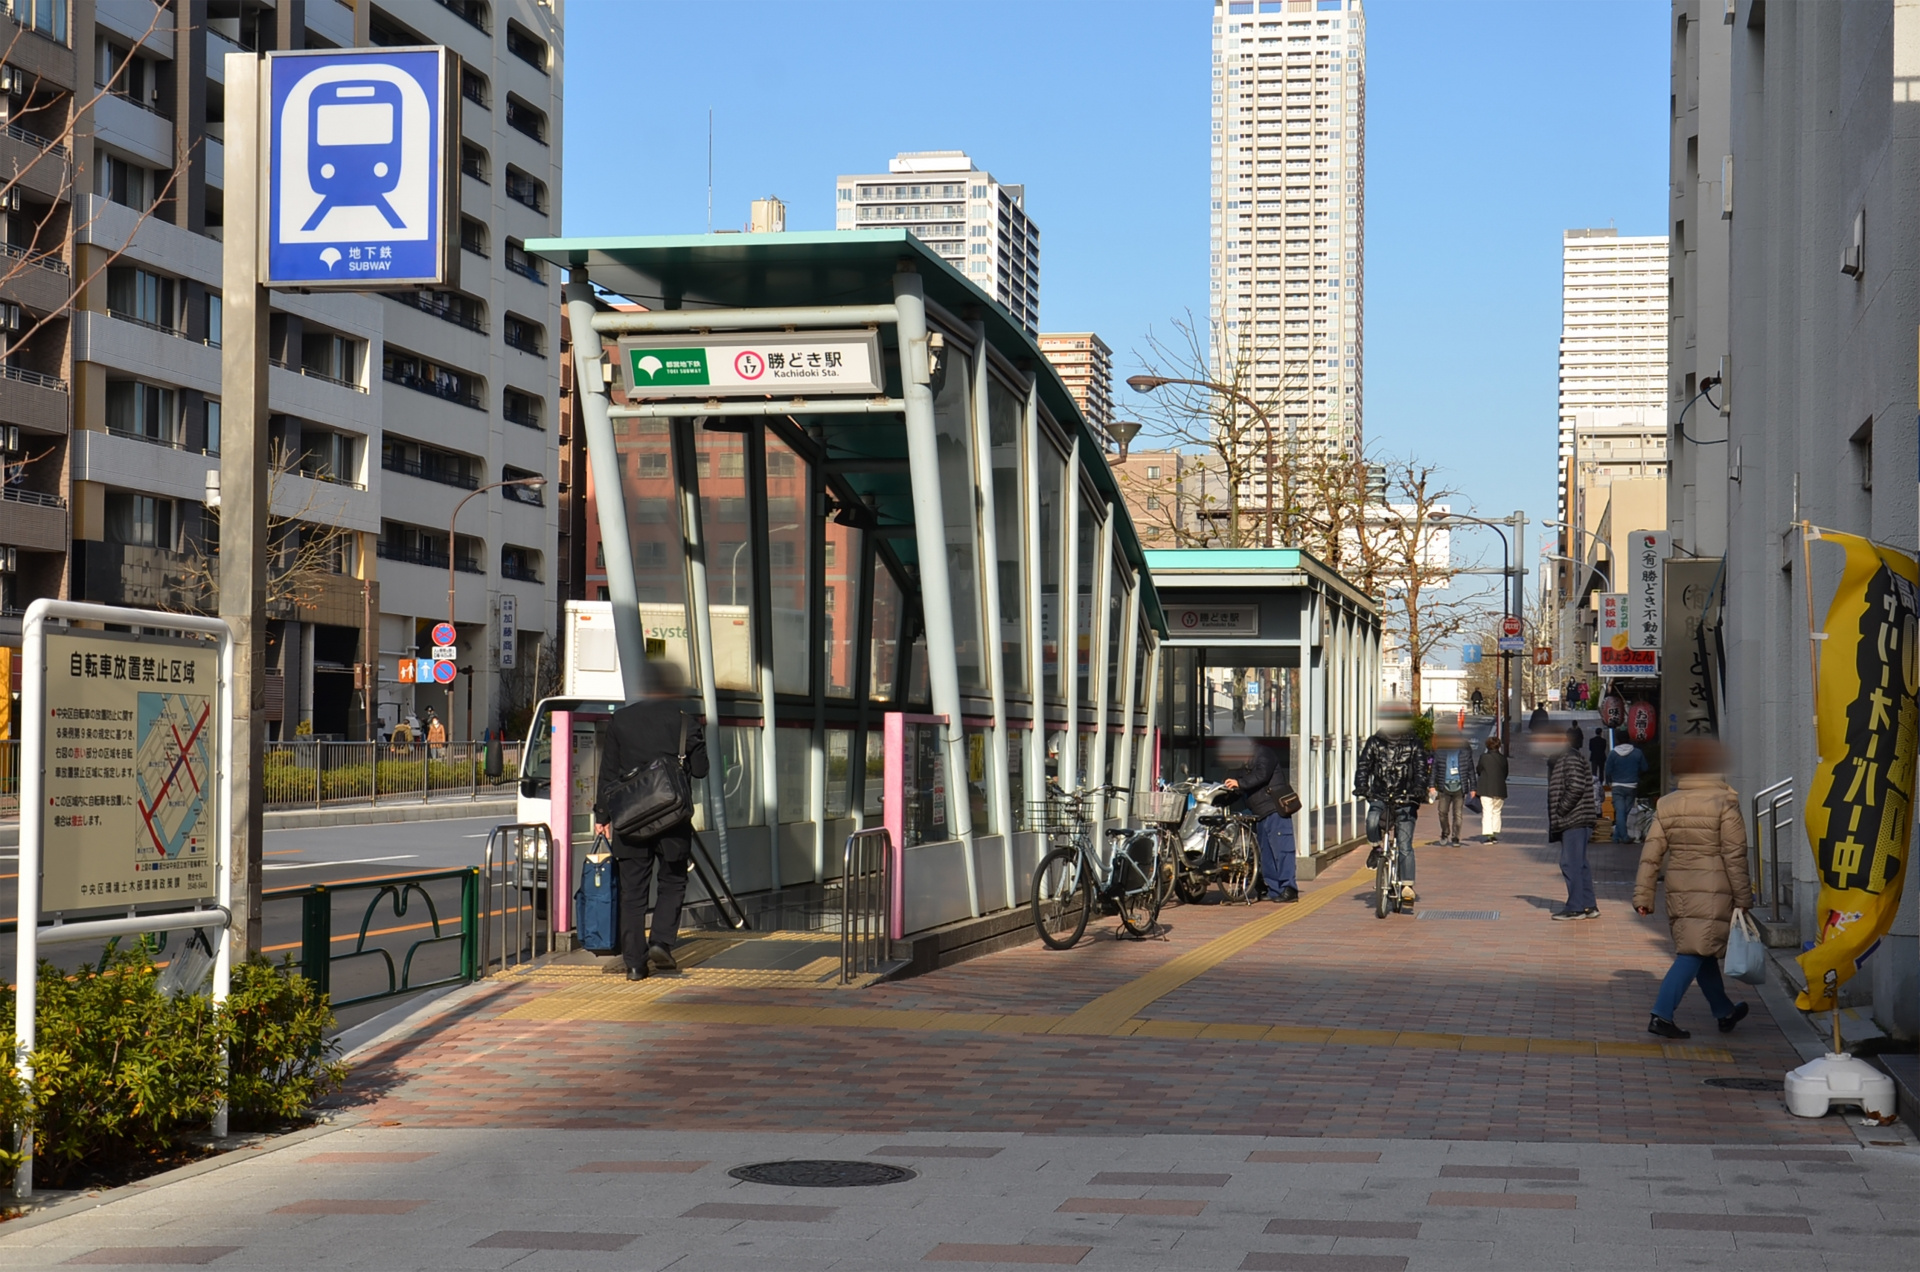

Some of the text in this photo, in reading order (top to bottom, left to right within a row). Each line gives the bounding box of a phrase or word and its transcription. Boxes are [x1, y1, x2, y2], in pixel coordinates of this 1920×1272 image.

[349, 246, 392, 259] 地下鉄
[349, 261, 391, 271] SUBWAY
[666, 361, 701, 369] 都営地下鉄
[746, 356, 751, 364] E
[768, 352, 842, 369] 勝どき駅
[743, 364, 756, 374] 17
[774, 368, 839, 378] Kachidoki Sta.
[1200, 612, 1239, 621] 勝どき駅
[1605, 597, 1616, 628] 鉄板焼
[503, 613, 513, 665] 加藤商店
[70, 652, 195, 684] 自転車放置禁止区域
